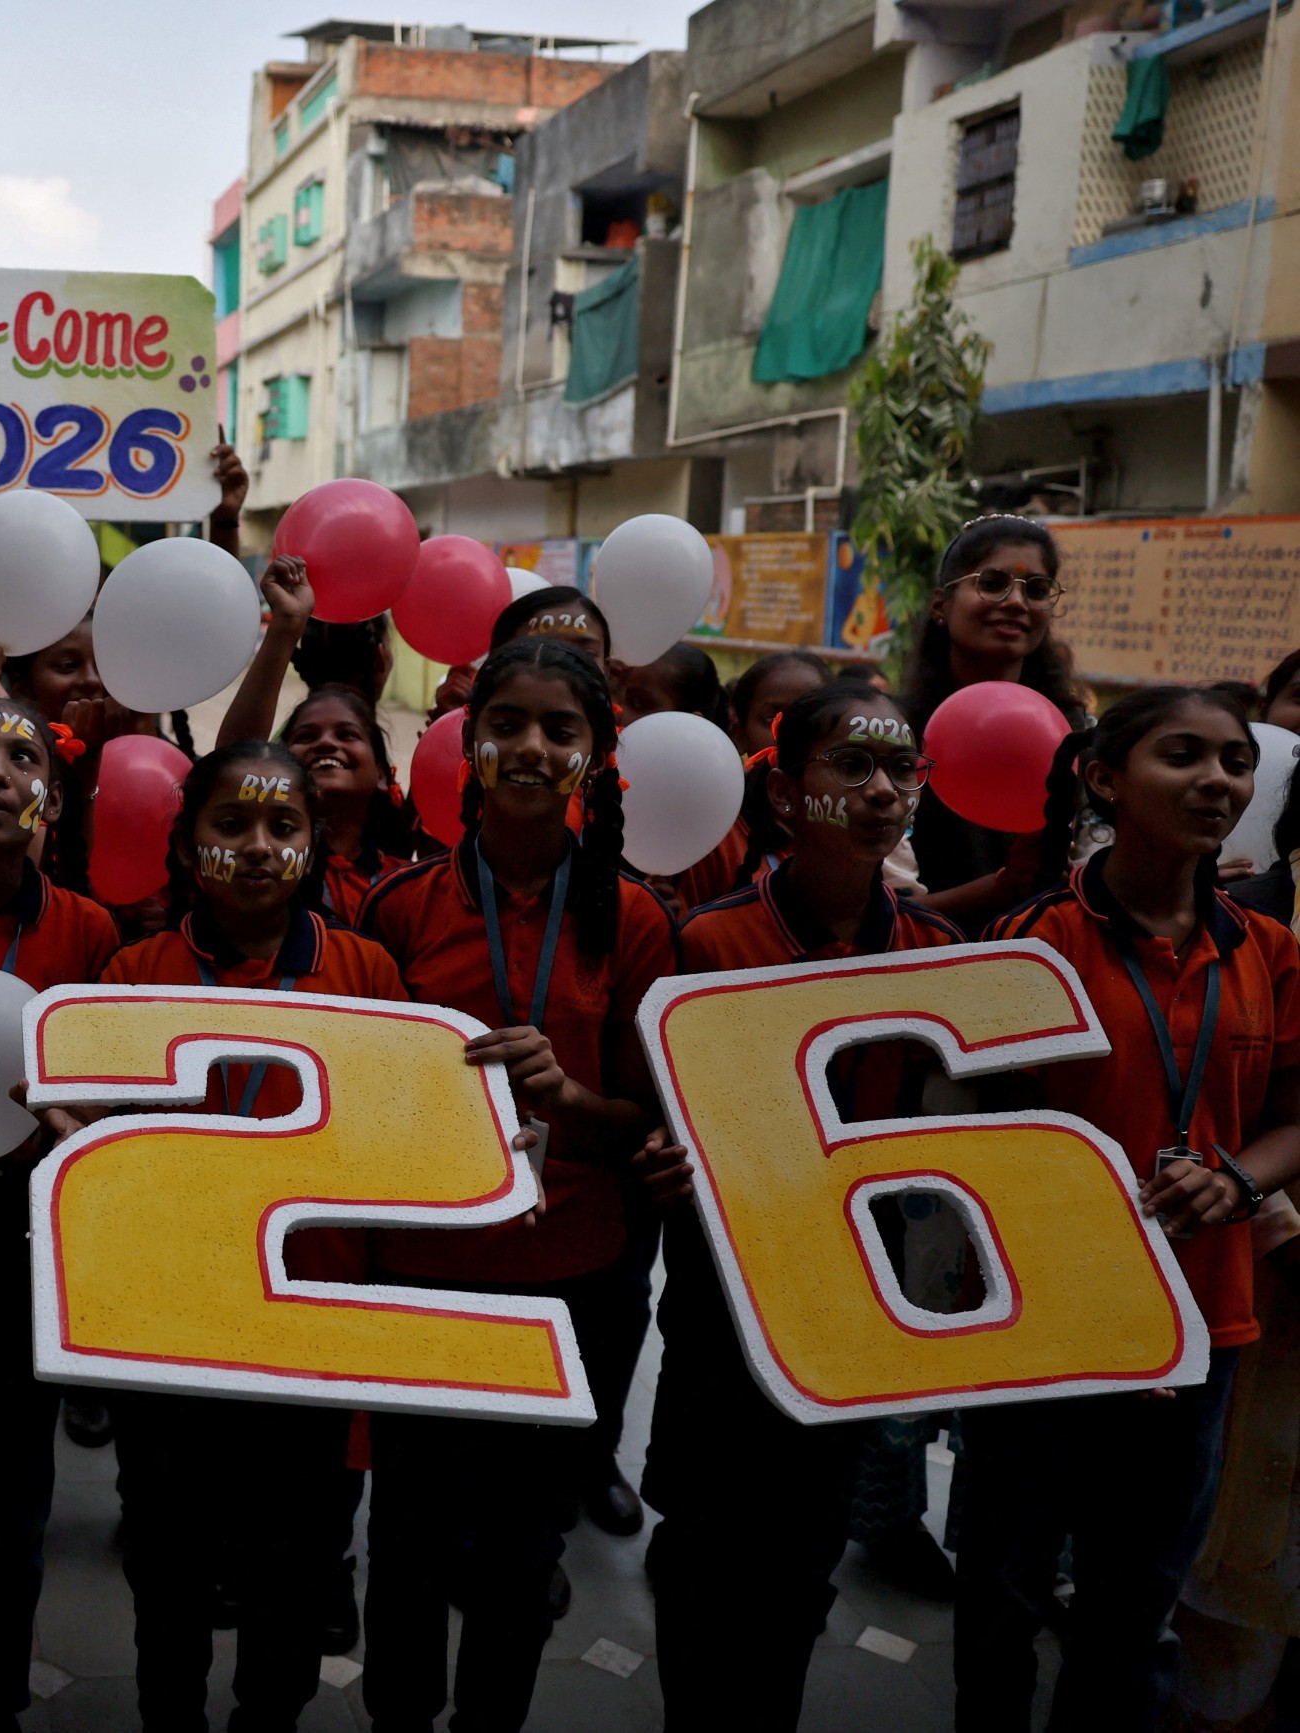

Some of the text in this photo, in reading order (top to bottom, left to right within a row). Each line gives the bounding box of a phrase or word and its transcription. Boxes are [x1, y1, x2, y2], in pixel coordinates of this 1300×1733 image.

[528, 614, 588, 636] 2026
[238, 774, 291, 802] BYE
[804, 793, 849, 829] 2026
[901, 796, 920, 825] 2
[197, 845, 236, 883] 2025
